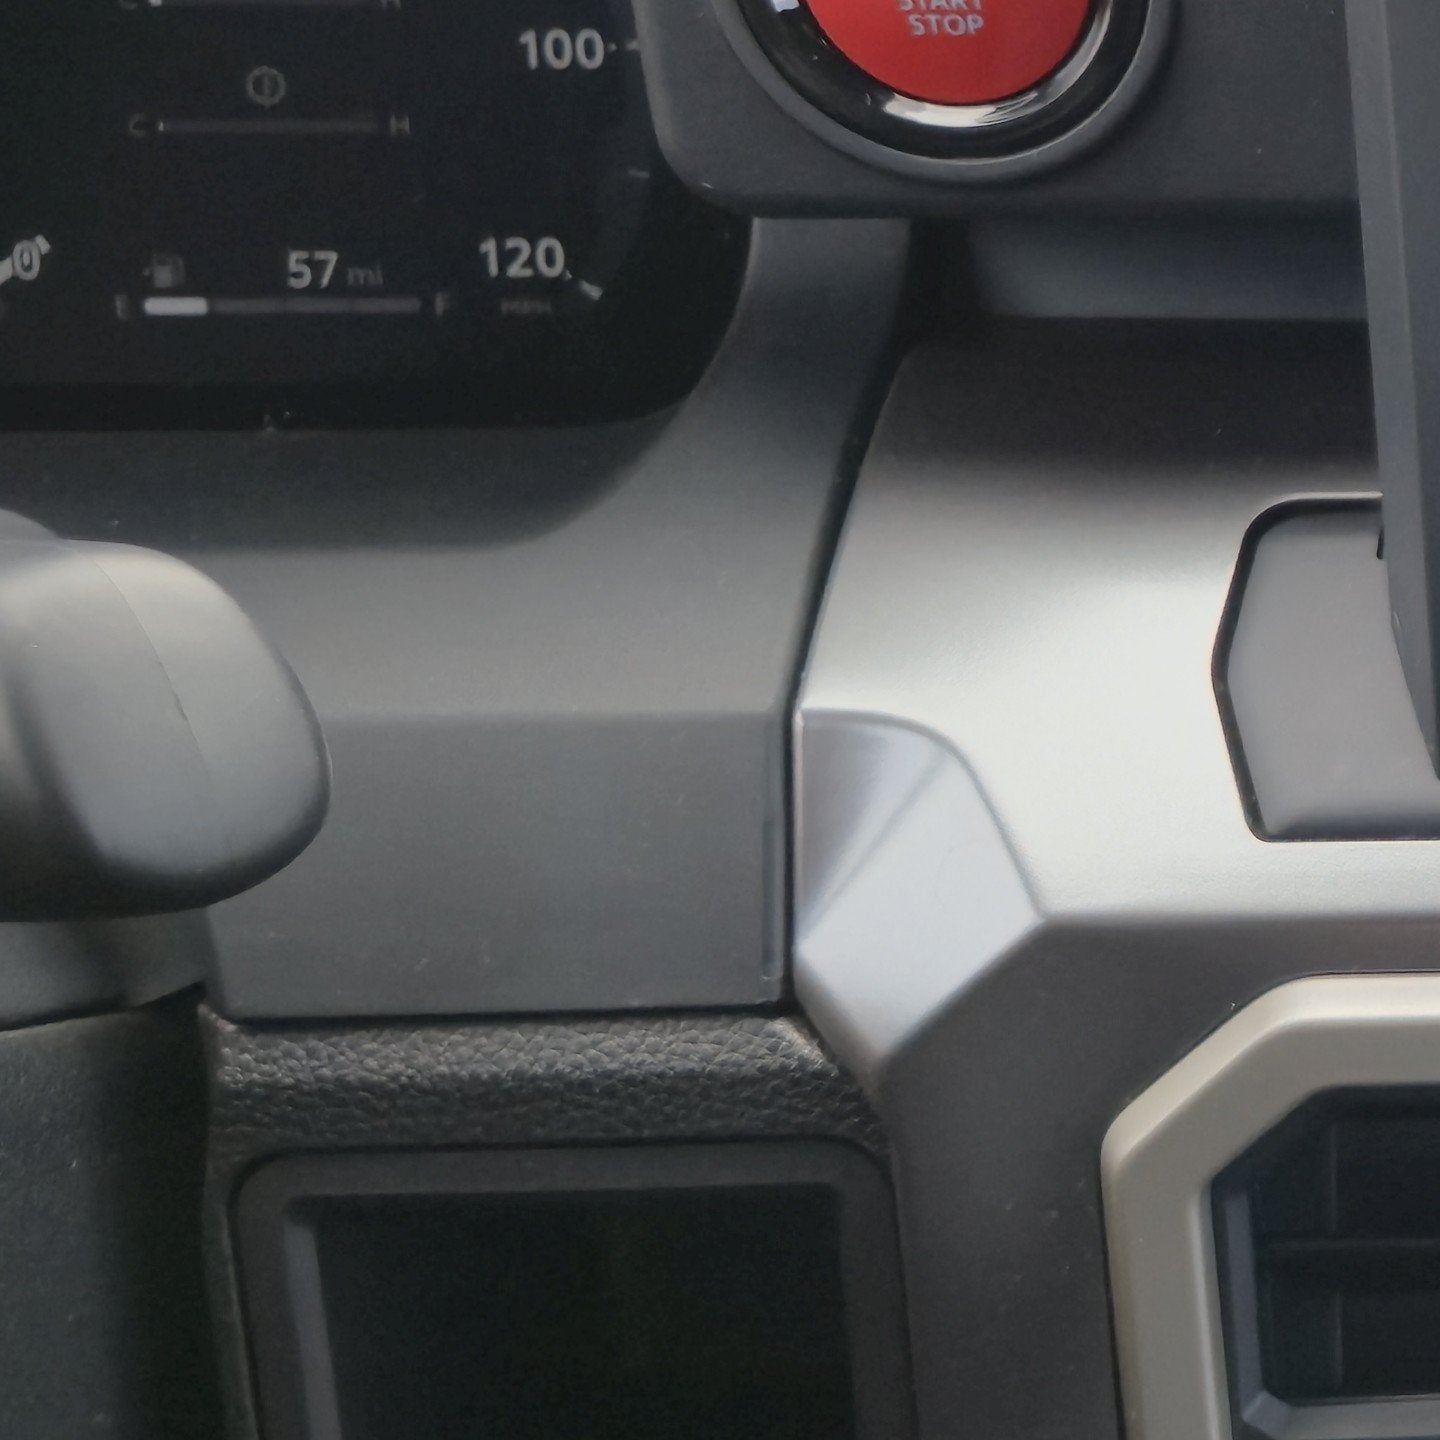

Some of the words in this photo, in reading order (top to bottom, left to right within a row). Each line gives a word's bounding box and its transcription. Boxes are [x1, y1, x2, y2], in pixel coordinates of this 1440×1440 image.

[908, 14, 985, 36] STOP
[518, 28, 606, 71] 100
[286, 250, 339, 289] 57
[478, 236, 565, 279] 120
